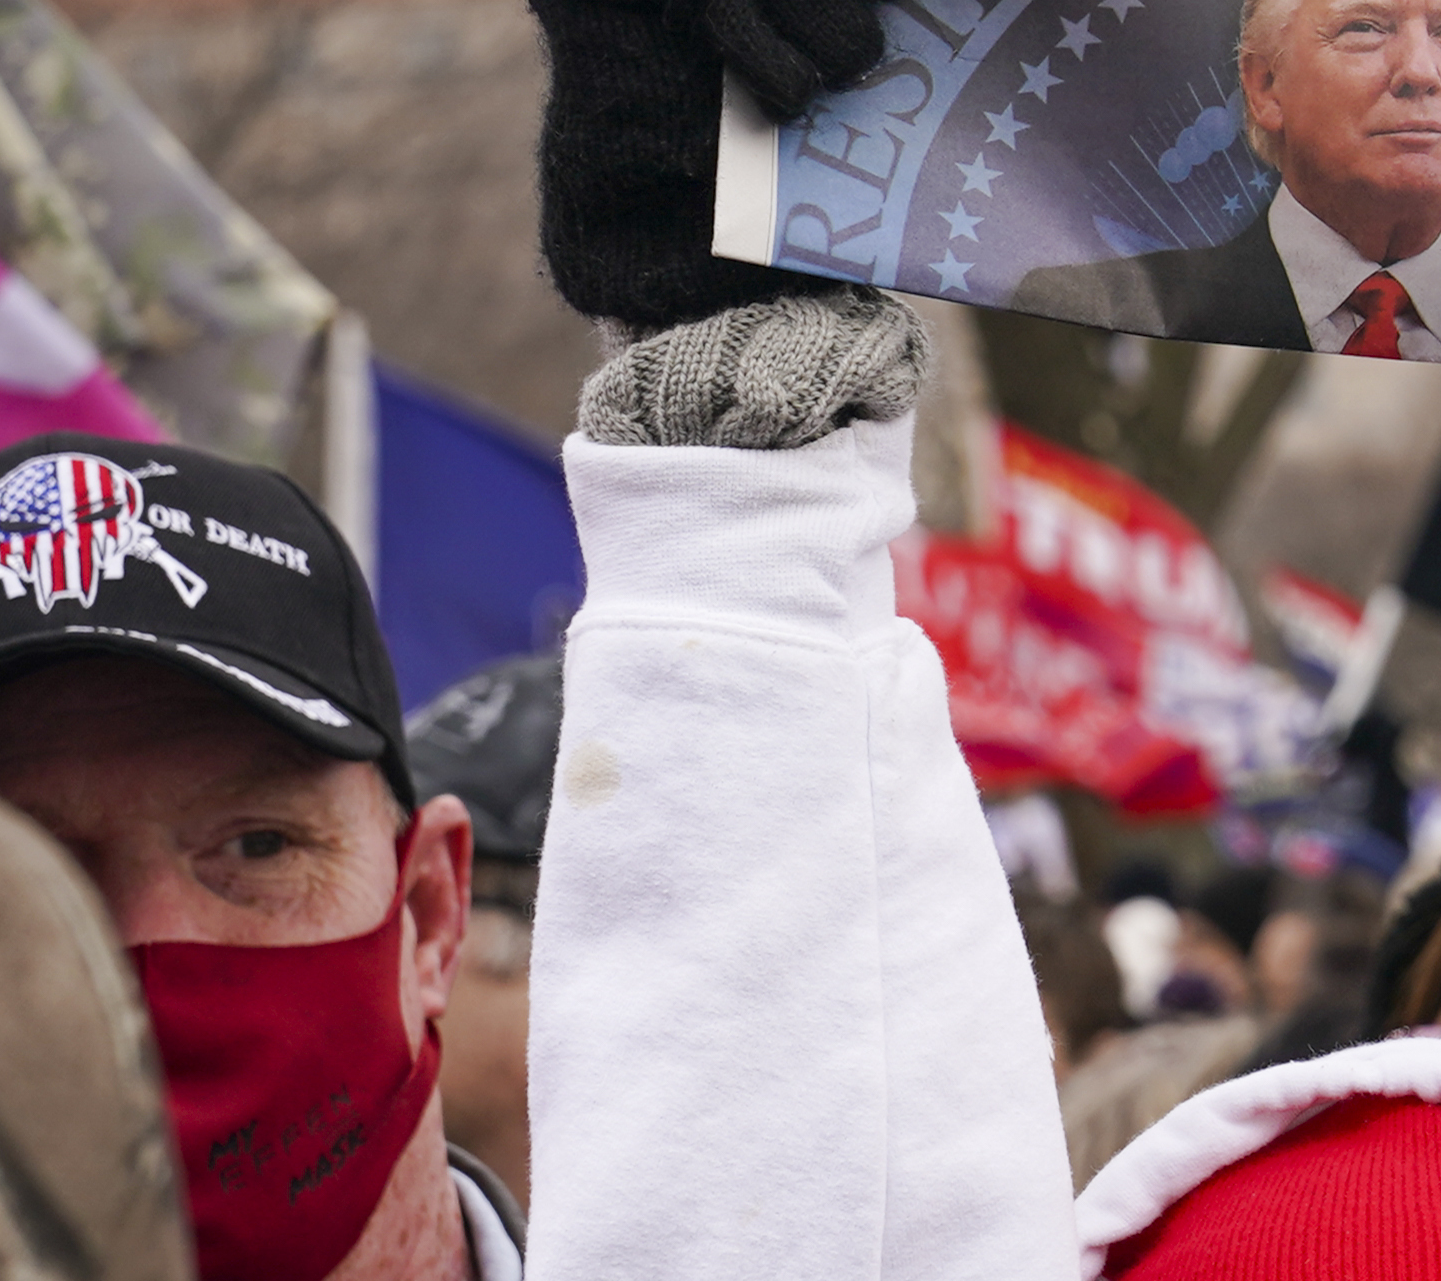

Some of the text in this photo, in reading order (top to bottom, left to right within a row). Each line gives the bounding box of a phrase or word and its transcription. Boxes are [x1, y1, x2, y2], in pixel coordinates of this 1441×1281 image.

[147, 503, 312, 578] OR DEATH
[207, 1119, 259, 1171] MY
[287, 1121, 369, 1209] MASK
